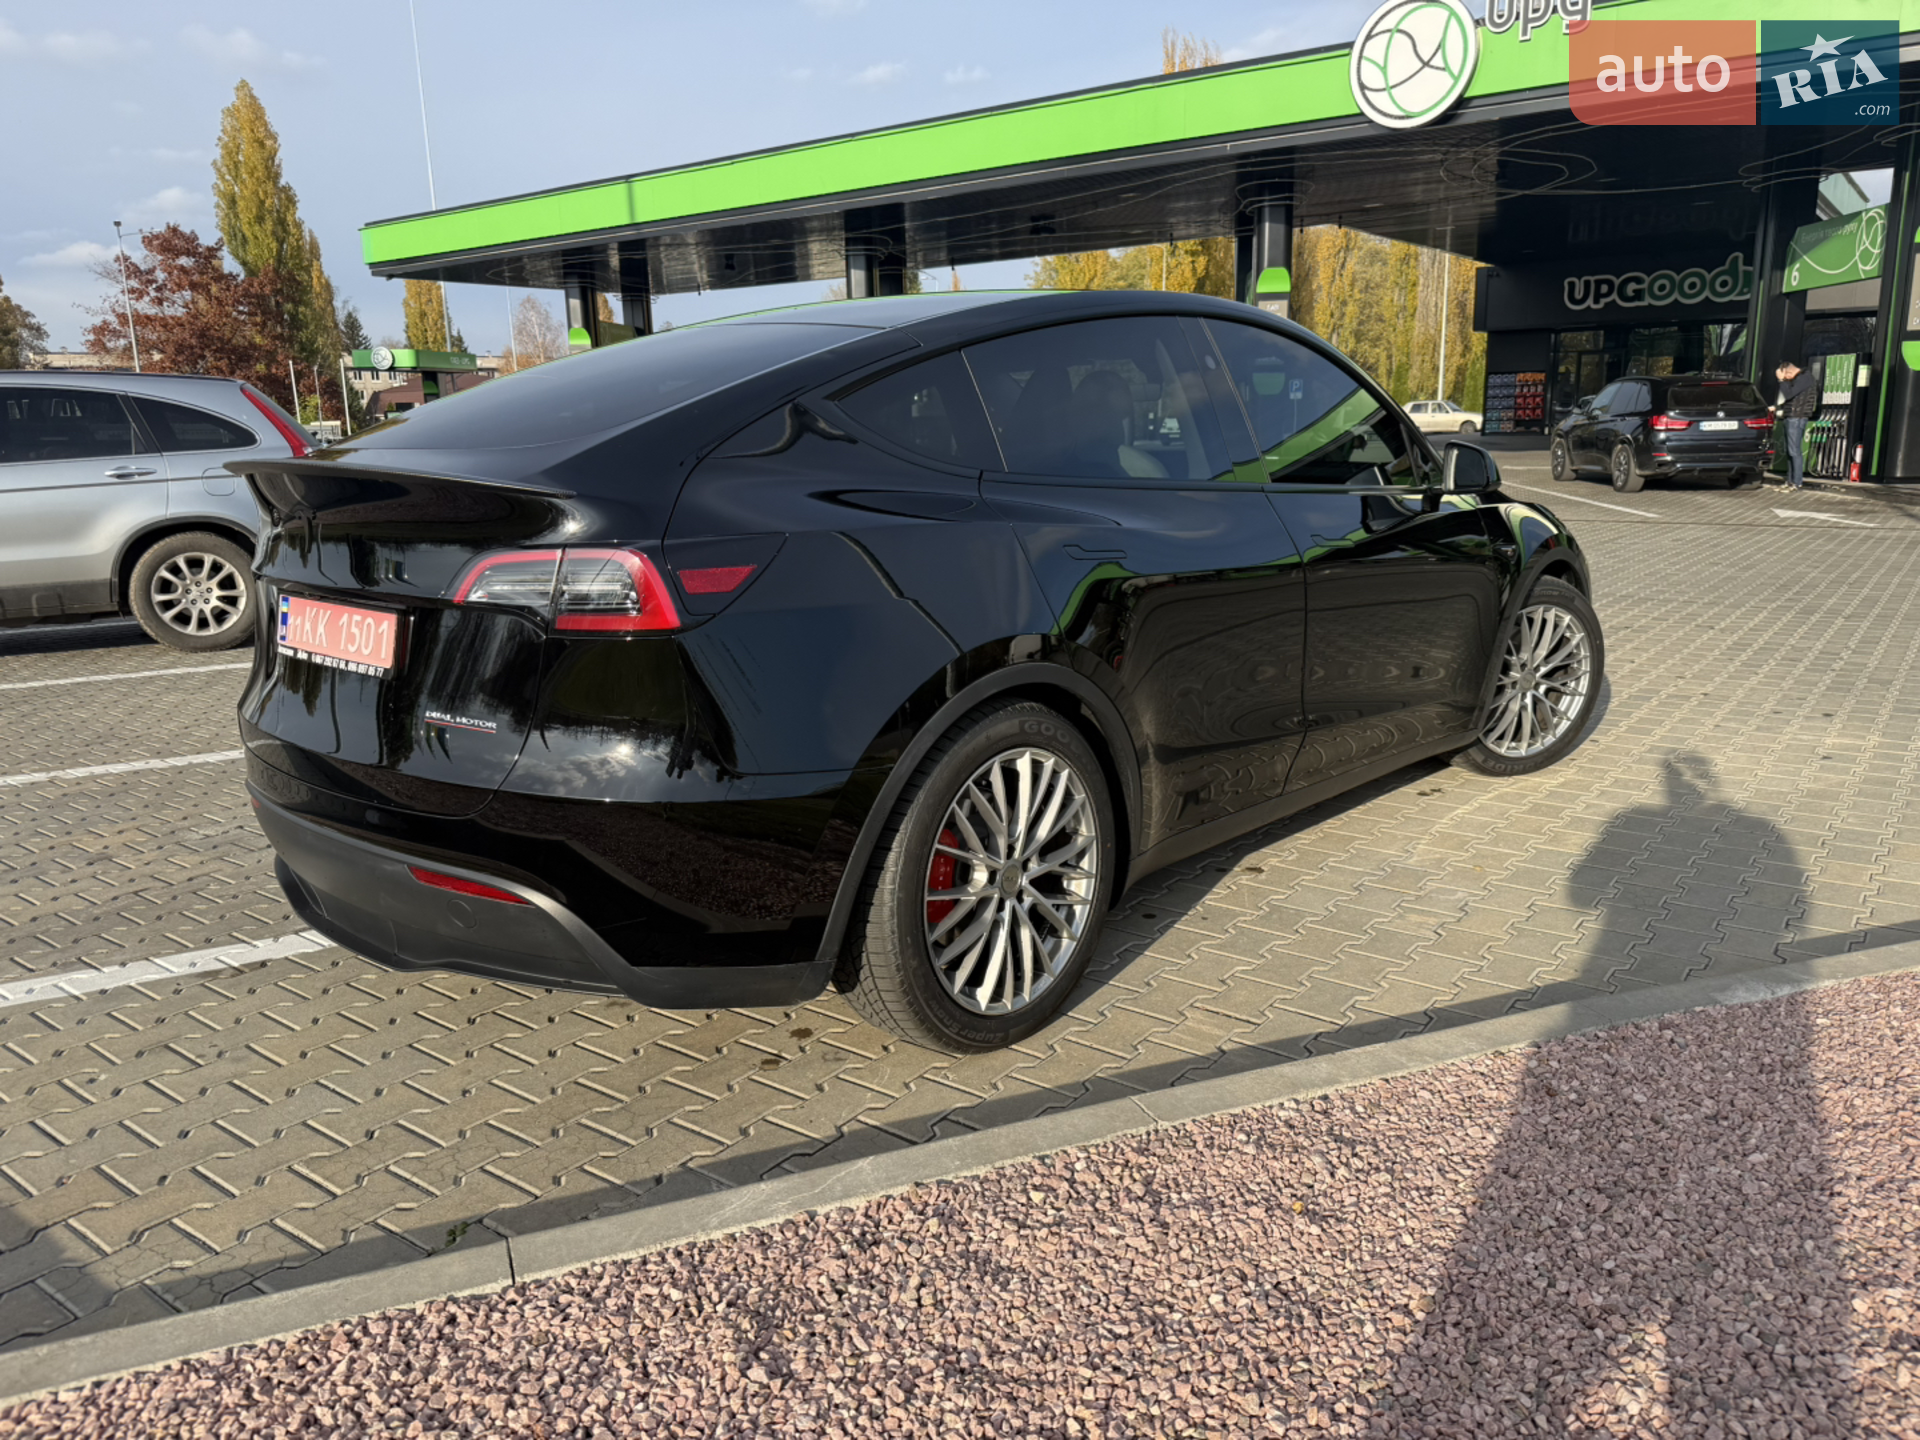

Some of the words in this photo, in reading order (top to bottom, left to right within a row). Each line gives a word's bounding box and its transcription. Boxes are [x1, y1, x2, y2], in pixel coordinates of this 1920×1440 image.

[1485, 0, 1591, 42] upg
[1791, 263, 1800, 287] 6
[1292, 381, 1300, 392] P
[339, 612, 389, 660] 1501
[425, 710, 454, 722] DUAL
[456, 716, 498, 729] MOTOR
